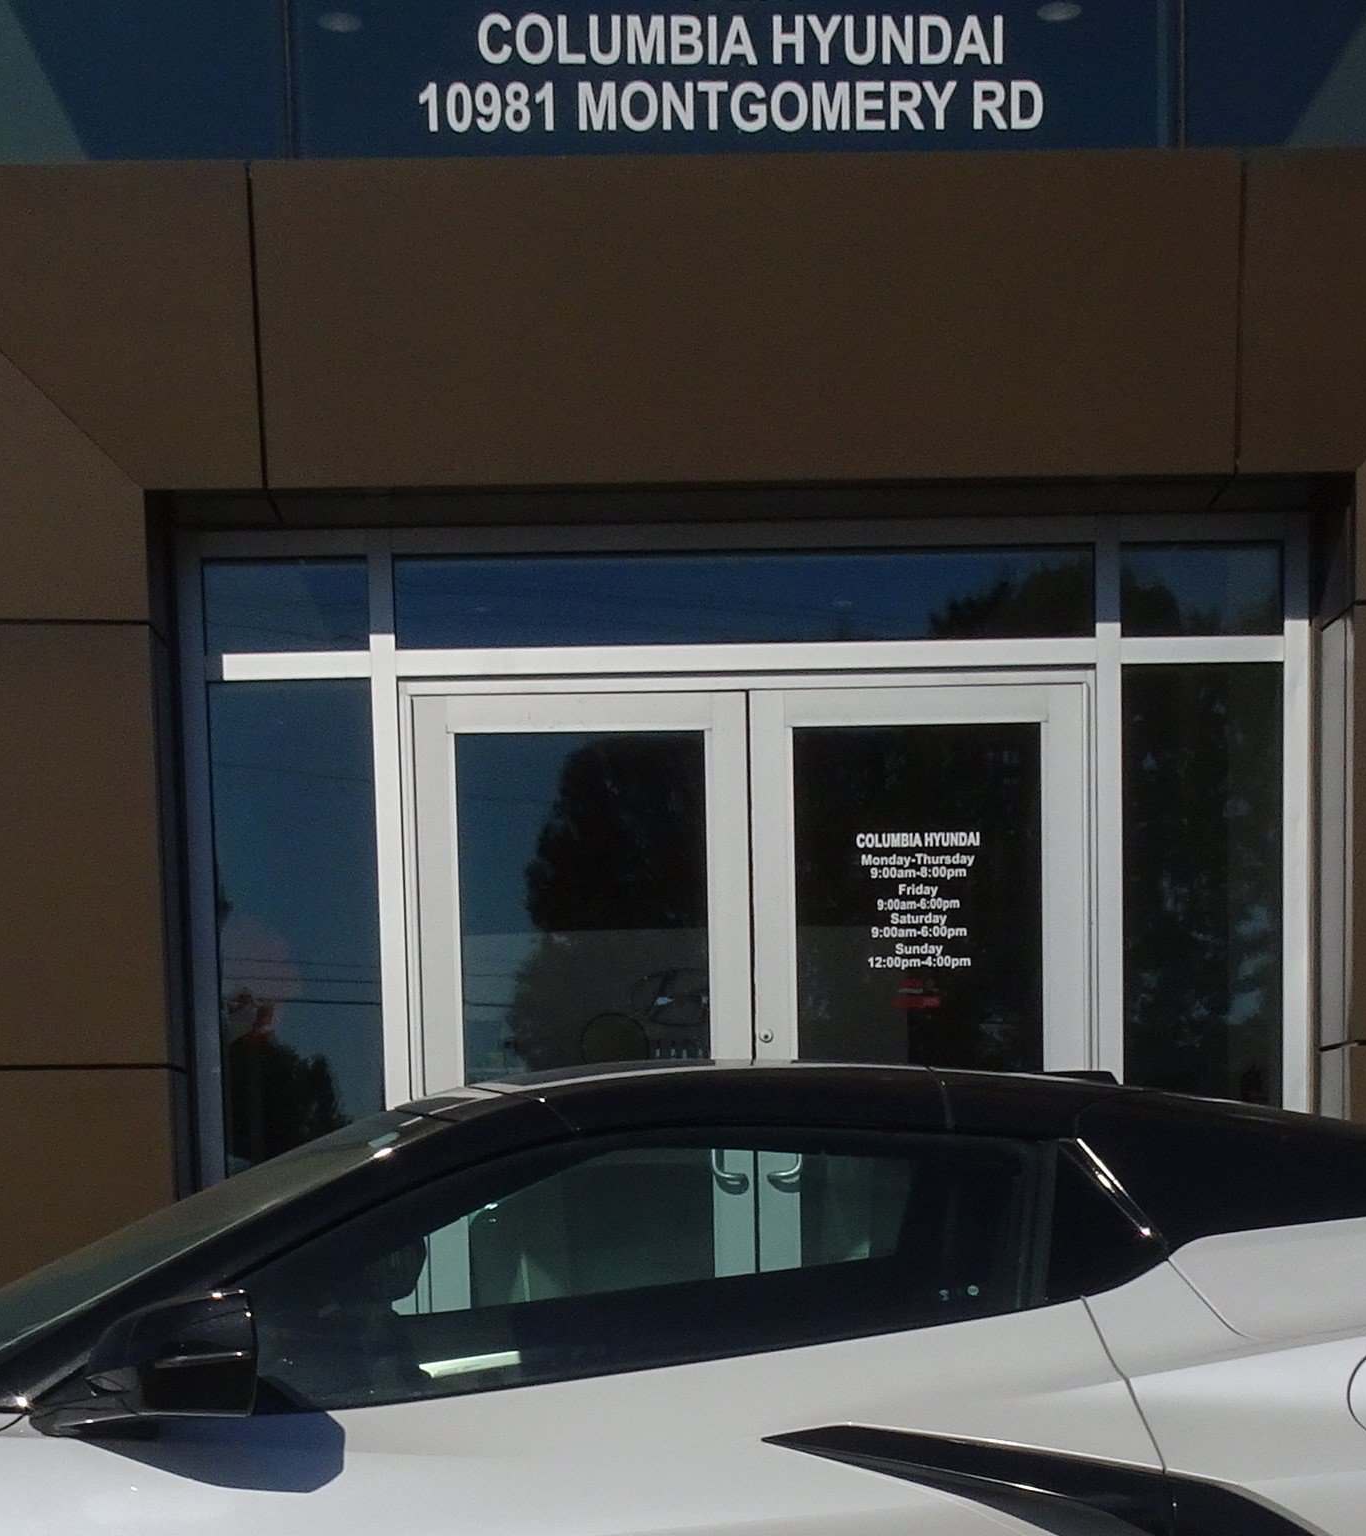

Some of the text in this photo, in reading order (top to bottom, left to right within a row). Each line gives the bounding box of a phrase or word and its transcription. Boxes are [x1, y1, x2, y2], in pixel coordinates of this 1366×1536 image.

[478, 13, 1003, 64] COLUMBIA HYUNDAI
[419, 81, 1043, 132] 10981 MONTGOMERY RD
[856, 832, 980, 848] COLUMBIA HYUNDAI
[861, 853, 974, 867] Monday-Thursday
[870, 866, 966, 880] 9:00am-8:00pm
[899, 884, 938, 897] Friday
[877, 898, 960, 911] 9:00am-6:00pm
[891, 912, 947, 926] Saturday
[871, 926, 967, 939] 9:00am-6:00pm
[895, 943, 943, 956] Sunday
[868, 956, 971, 970] 12:00pm-4:00pm
